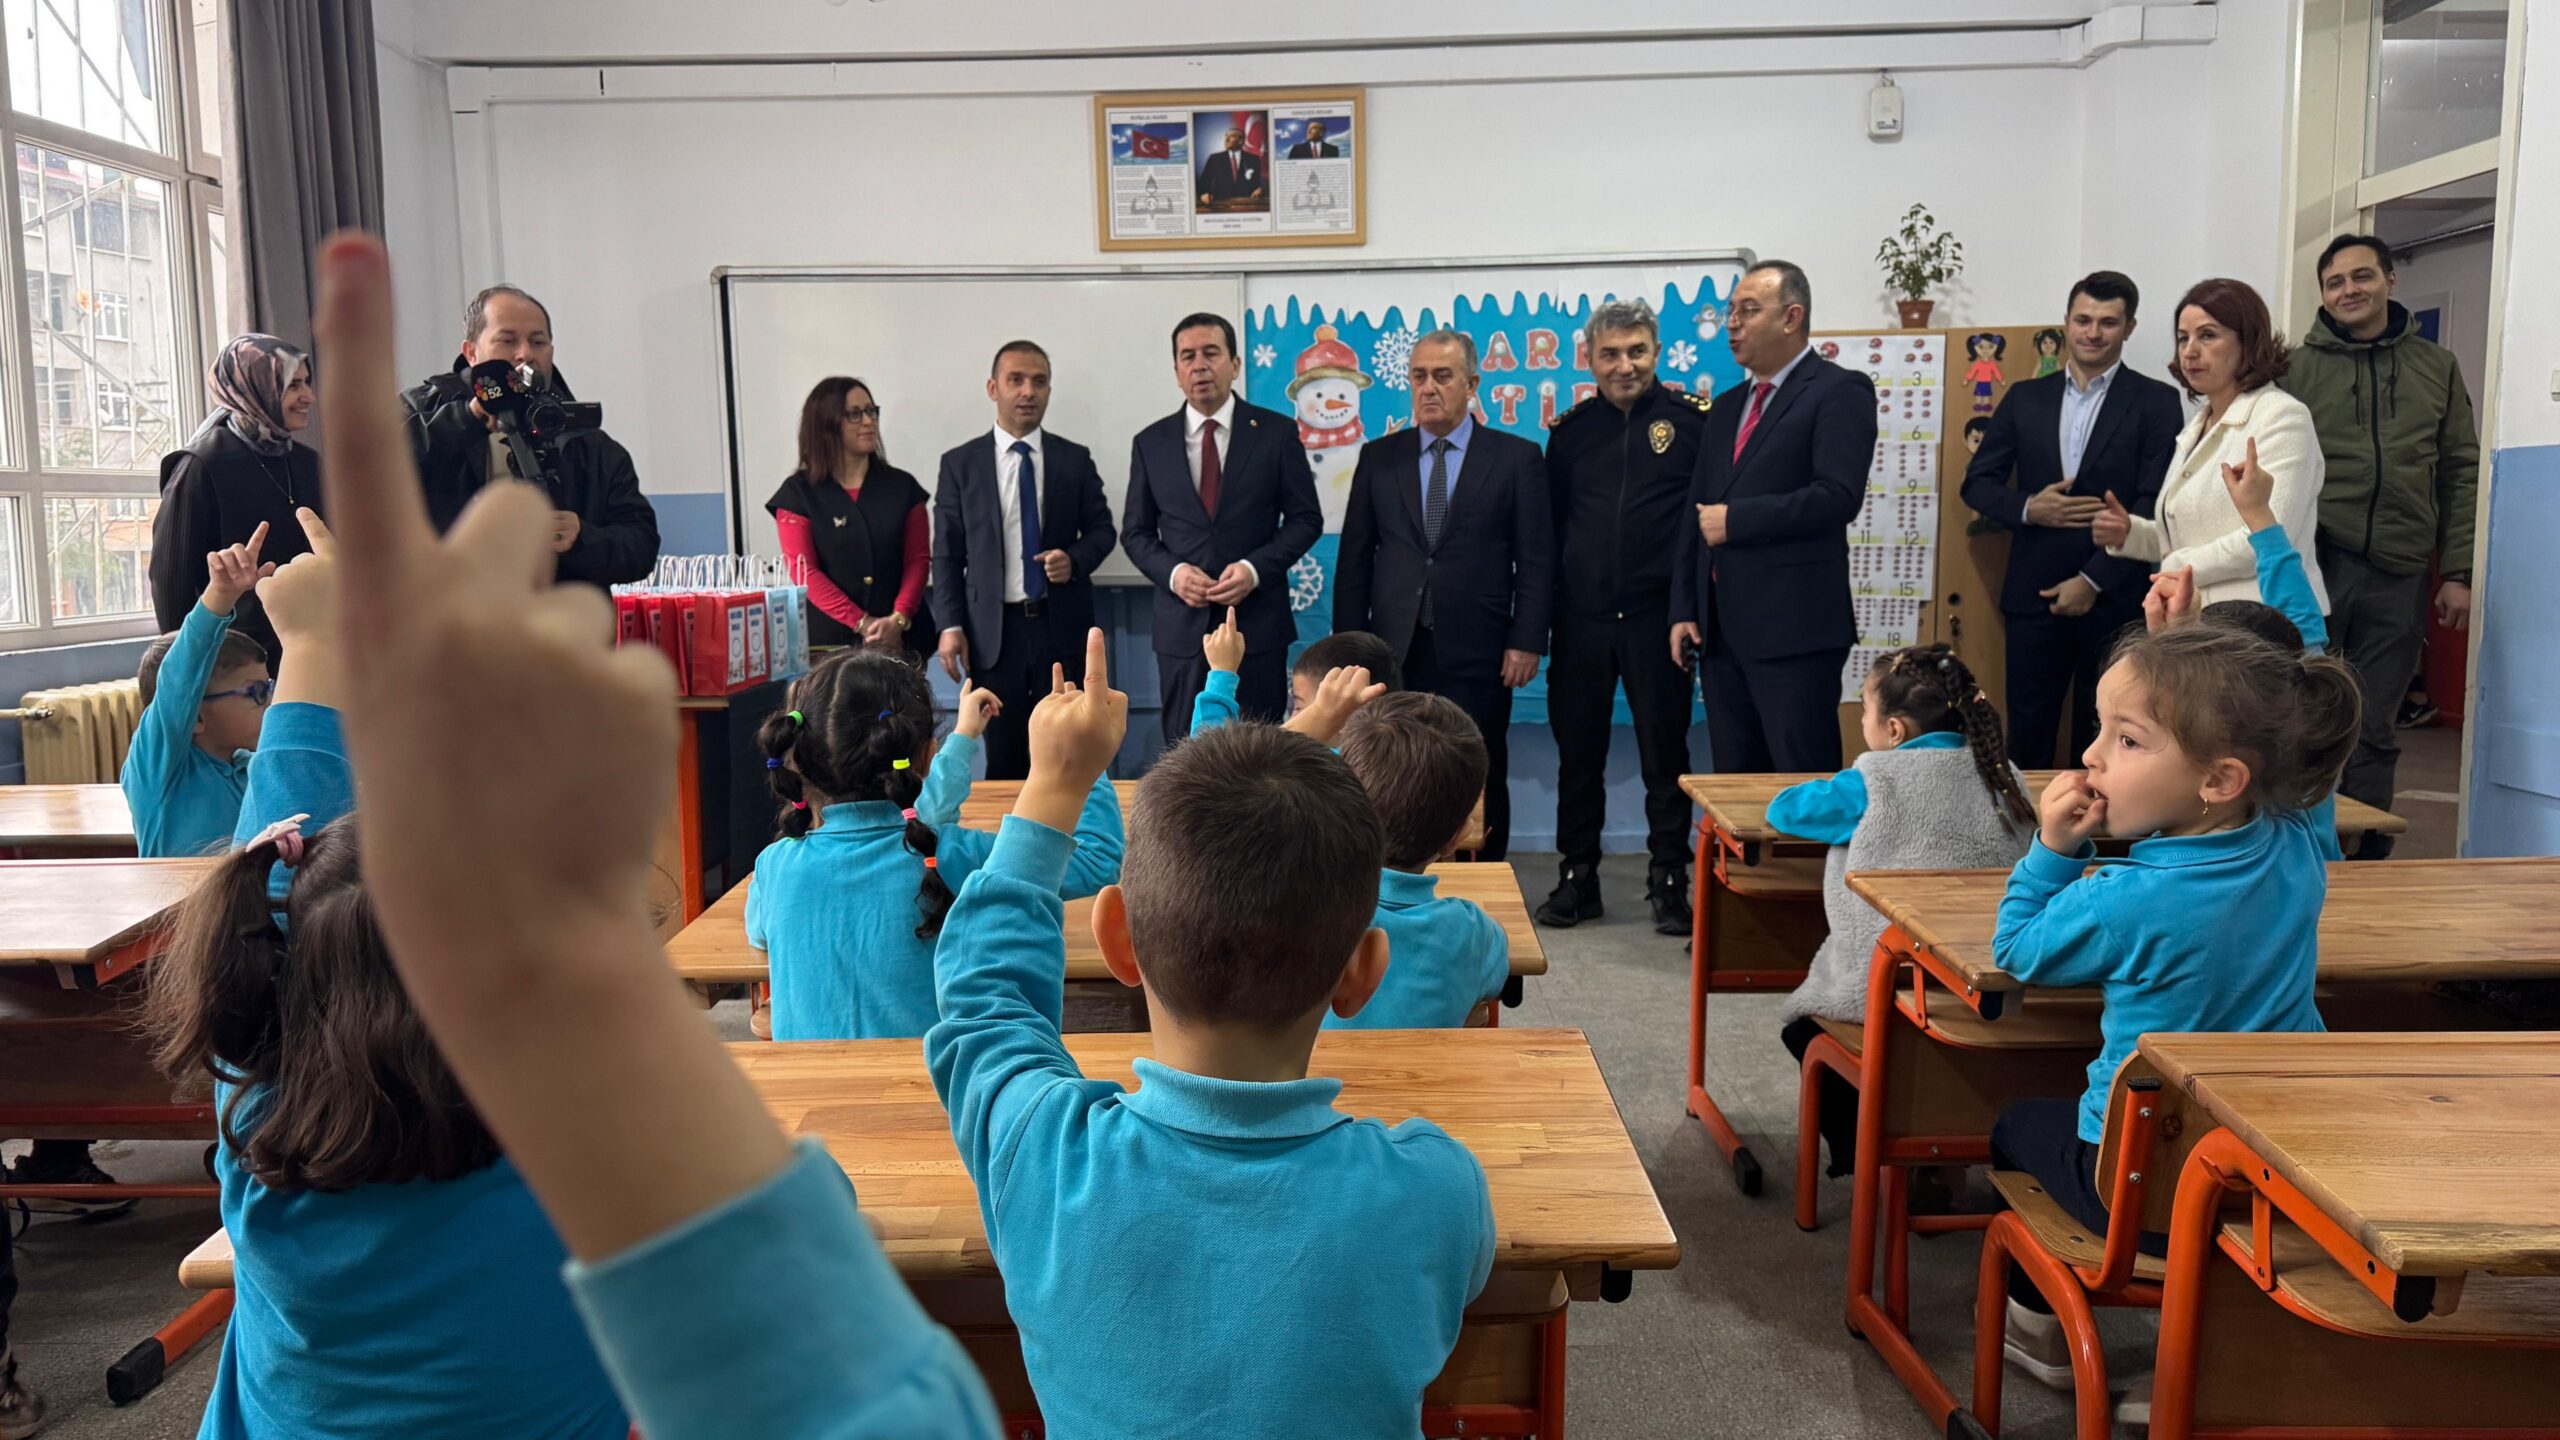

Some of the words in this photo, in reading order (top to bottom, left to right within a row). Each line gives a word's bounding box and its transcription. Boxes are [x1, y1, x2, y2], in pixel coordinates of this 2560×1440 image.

[1912, 371, 1922, 387] 3
[487, 386, 504, 399] 52
[1911, 425, 1922, 441] 6
[1907, 479, 1918, 494] 9
[1860, 530, 1871, 545] 11
[1904, 531, 1919, 545] 12
[1858, 581, 1873, 596] 14
[1899, 581, 1915, 597] 15
[1887, 632, 1901, 648] 18
